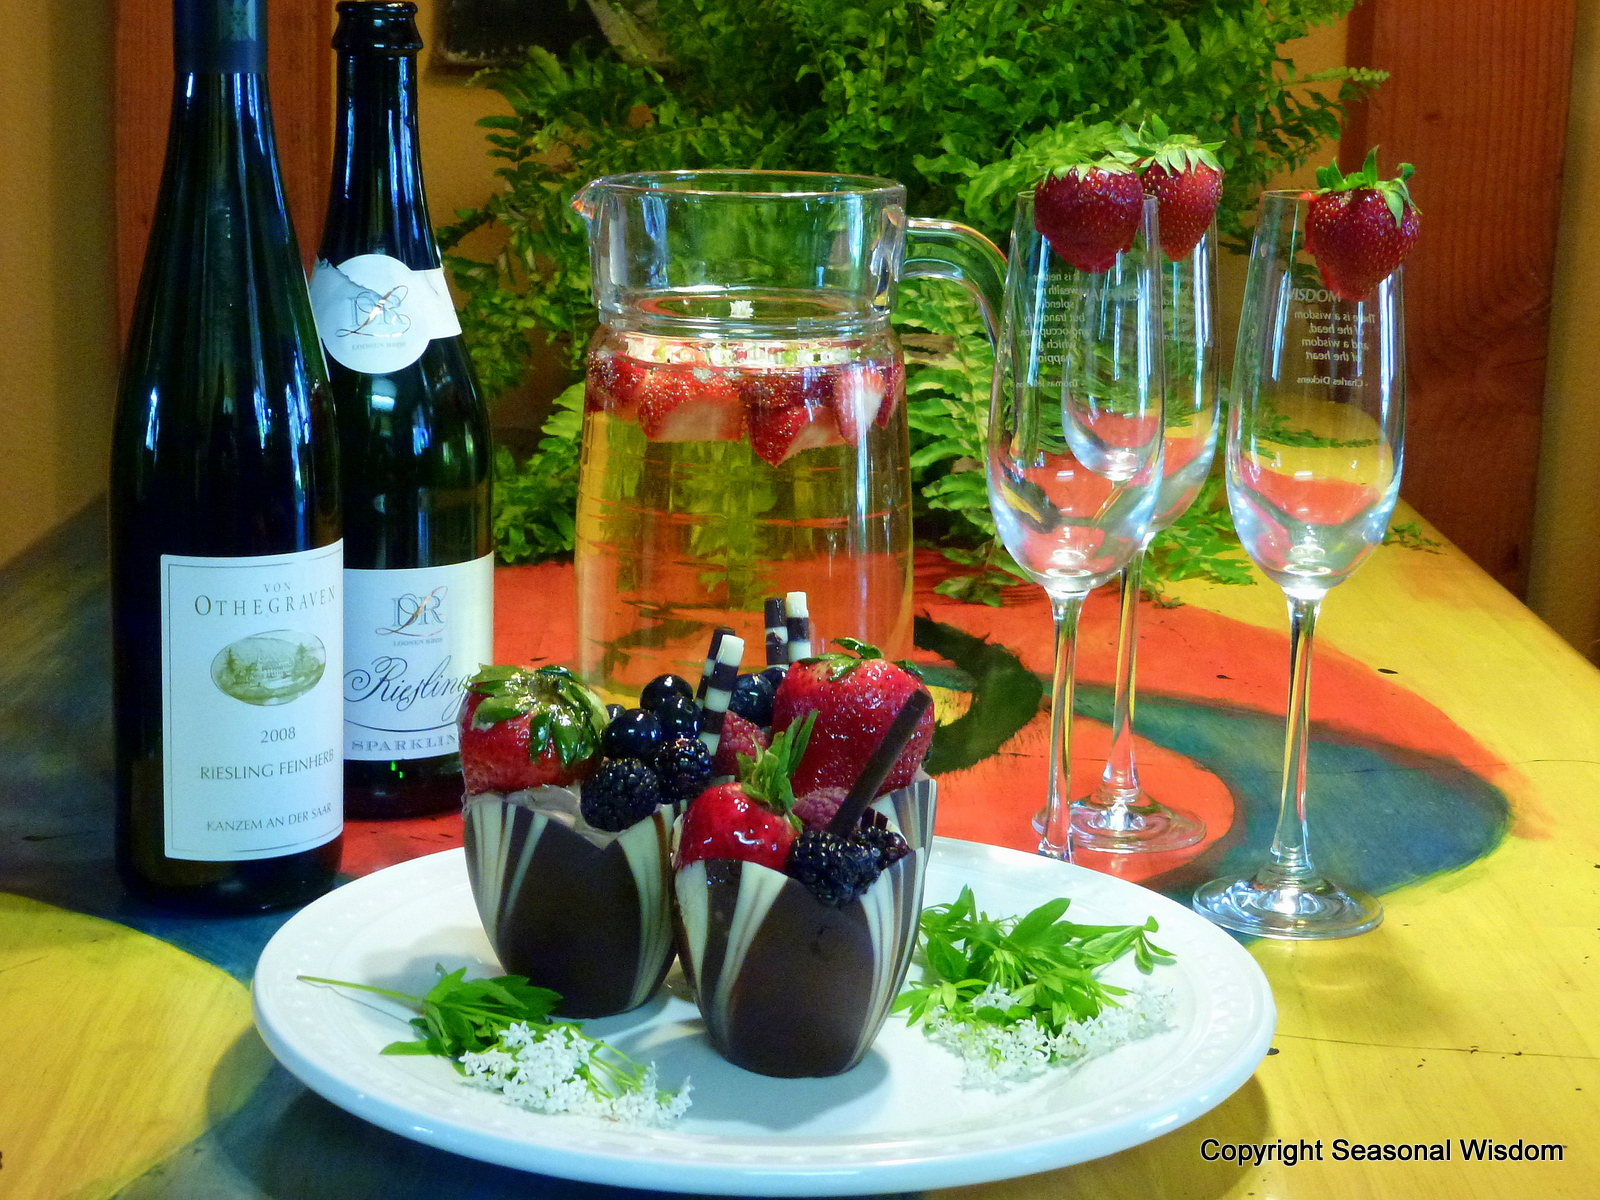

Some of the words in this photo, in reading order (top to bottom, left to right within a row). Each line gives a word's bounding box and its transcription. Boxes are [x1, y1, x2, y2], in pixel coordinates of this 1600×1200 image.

[194, 585, 336, 616] OTHEGRAVEN
[263, 580, 292, 594] VON
[343, 655, 472, 722] Riesling
[261, 726, 296, 744] 2008
[351, 732, 457, 752] SPARKLIN
[200, 763, 274, 780] RIESLING
[279, 748, 334, 776] FEINHERB
[206, 819, 263, 832] KANZEM
[265, 816, 285, 828] AN
[288, 811, 309, 825] DER
[311, 801, 332, 820] SAAR
